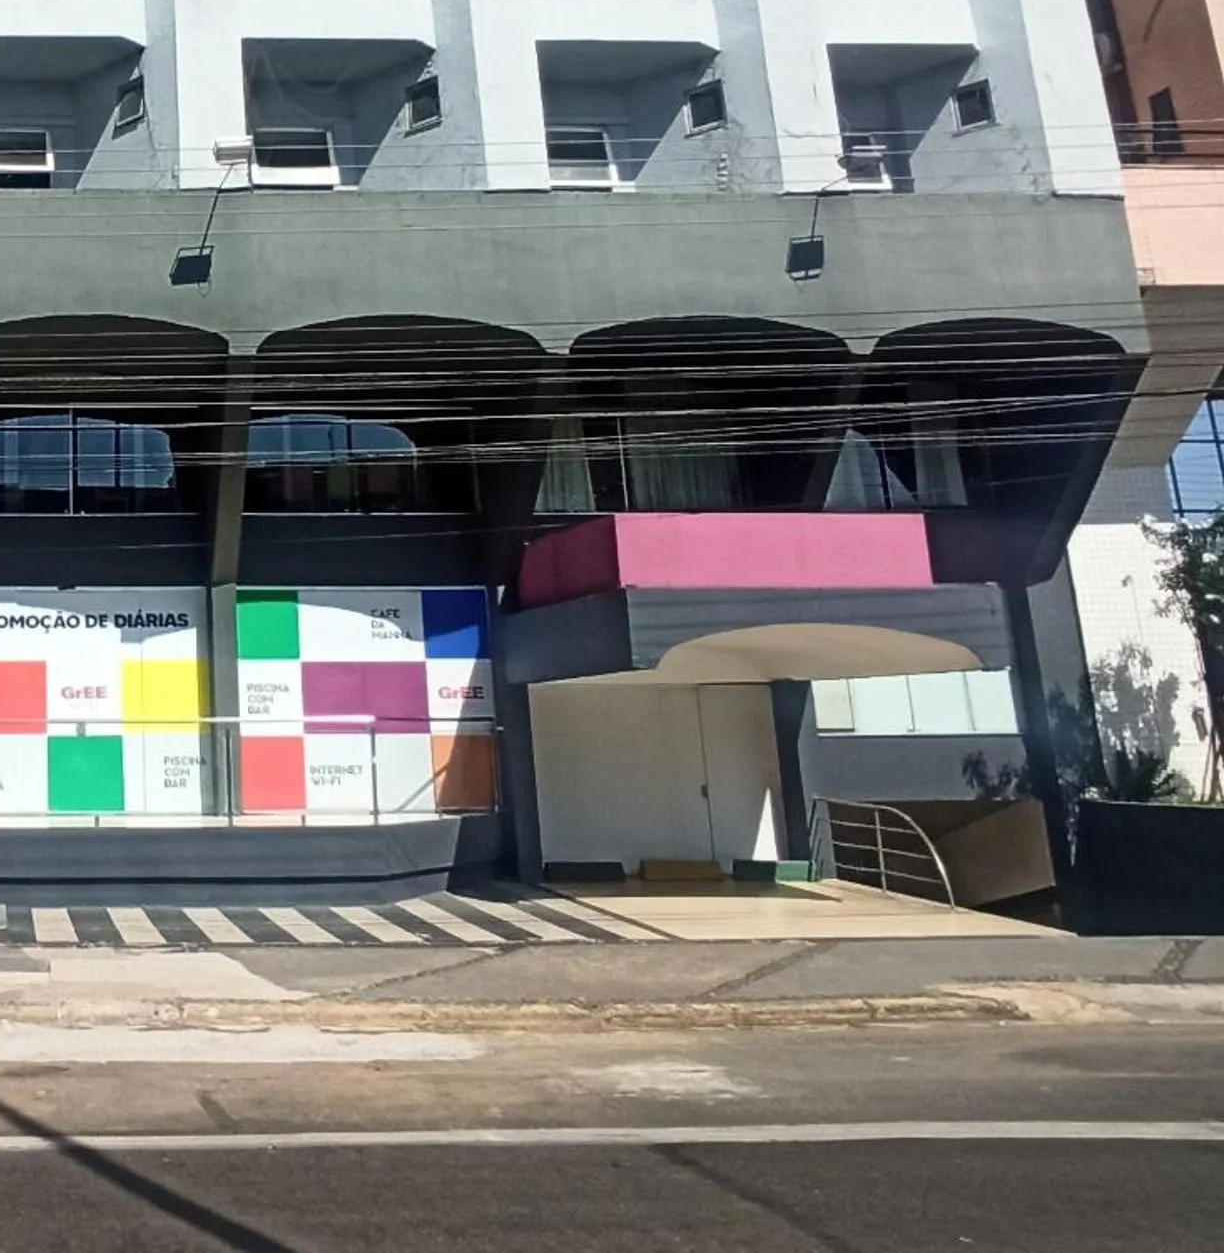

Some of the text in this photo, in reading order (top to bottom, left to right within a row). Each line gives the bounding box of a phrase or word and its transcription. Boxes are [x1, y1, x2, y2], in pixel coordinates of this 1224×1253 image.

[85, 613, 108, 628] DE
[114, 609, 189, 628] DIÁRIAS
[60, 685, 108, 700] GrEE
[437, 686, 485, 699] GrEE
[163, 756, 207, 766] PISCINA
[309, 764, 363, 776] INTERNET
